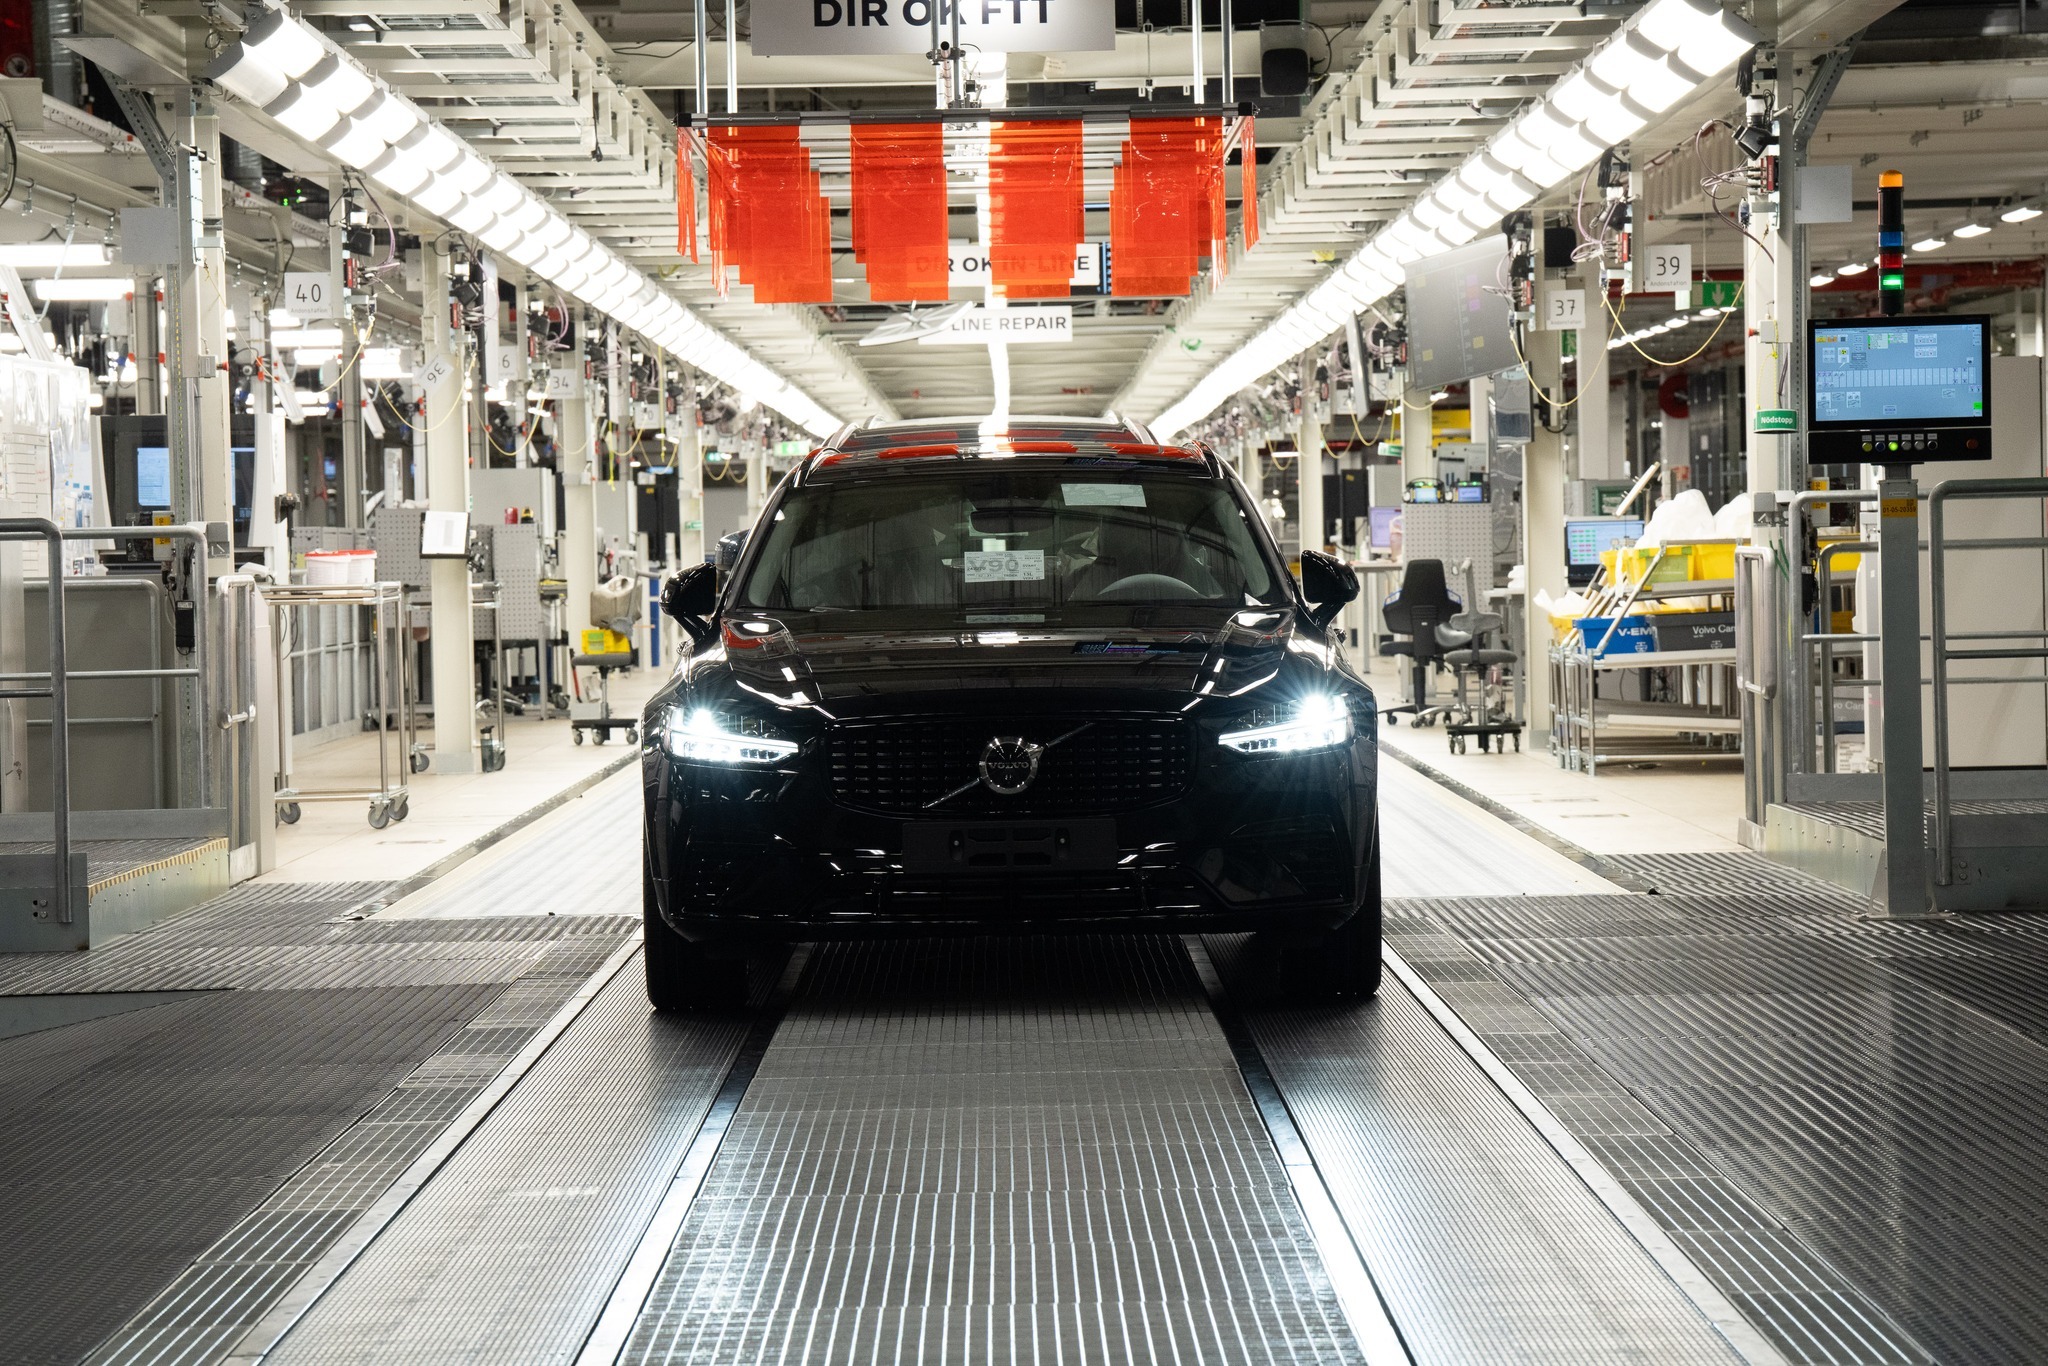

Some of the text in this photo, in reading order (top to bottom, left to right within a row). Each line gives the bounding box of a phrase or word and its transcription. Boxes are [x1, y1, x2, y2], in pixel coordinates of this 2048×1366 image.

[813, 0, 1055, 27] DIR OK FTT
[962, 257, 992, 272] OK
[1655, 256, 1681, 276] 39
[296, 283, 321, 303] 40
[1555, 299, 1576, 317] 37
[999, 316, 1067, 330] REPAIR
[553, 376, 569, 389] 34
[1761, 416, 1794, 425] Nödstopp
[967, 558, 1020, 573] V90
[1617, 627, 1652, 637] V-EM
[1692, 623, 1737, 635] Volvo Car
[988, 761, 1030, 769] VOLVO
